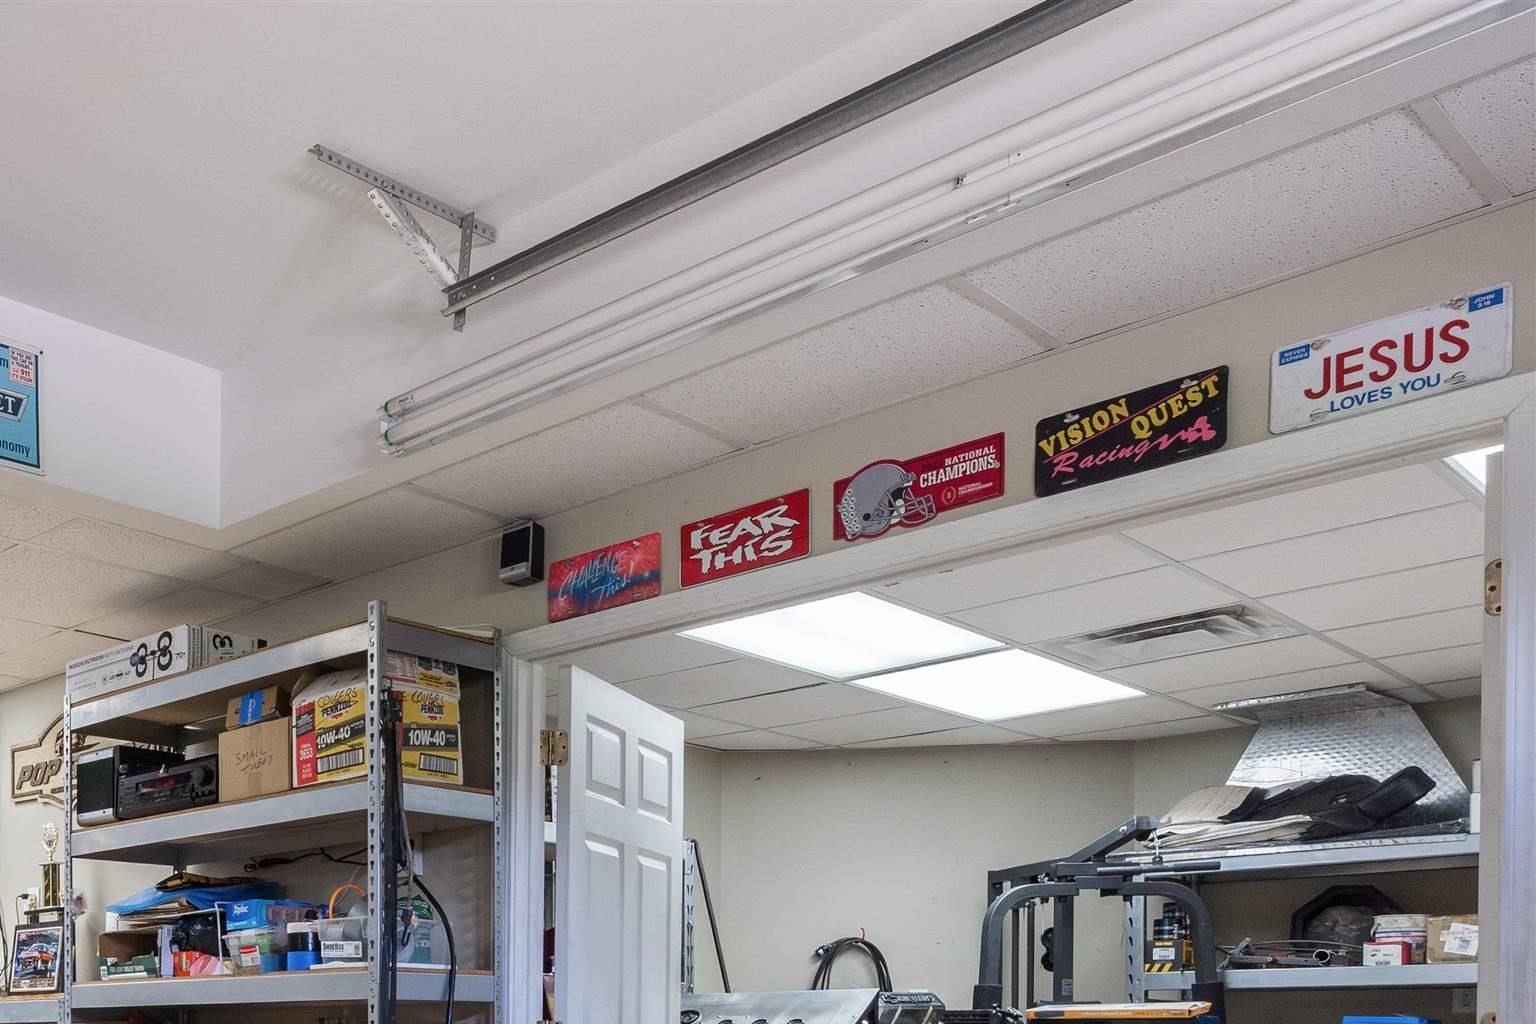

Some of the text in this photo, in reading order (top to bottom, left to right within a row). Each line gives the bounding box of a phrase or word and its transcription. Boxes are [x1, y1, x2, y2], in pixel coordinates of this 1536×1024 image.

[1474, 293, 1495, 304] JOHN
[1303, 318, 1470, 400] JESUS
[1130, 374, 1220, 440] QUEST
[1329, 372, 1441, 413] LOVES YOU
[1038, 397, 1130, 458] VISION
[919, 453, 996, 488] CHAMPIONS
[944, 445, 996, 466] NATIONAL
[1050, 439, 1152, 479] Racing
[689, 500, 801, 551] FEAR
[689, 529, 794, 576] THIS
[558, 550, 630, 601] CHALLENGE
[318, 687, 358, 708] COVERS
[316, 726, 351, 750] 10W-40
[408, 728, 446, 746] 10W-40
[16, 758, 63, 791] POP
